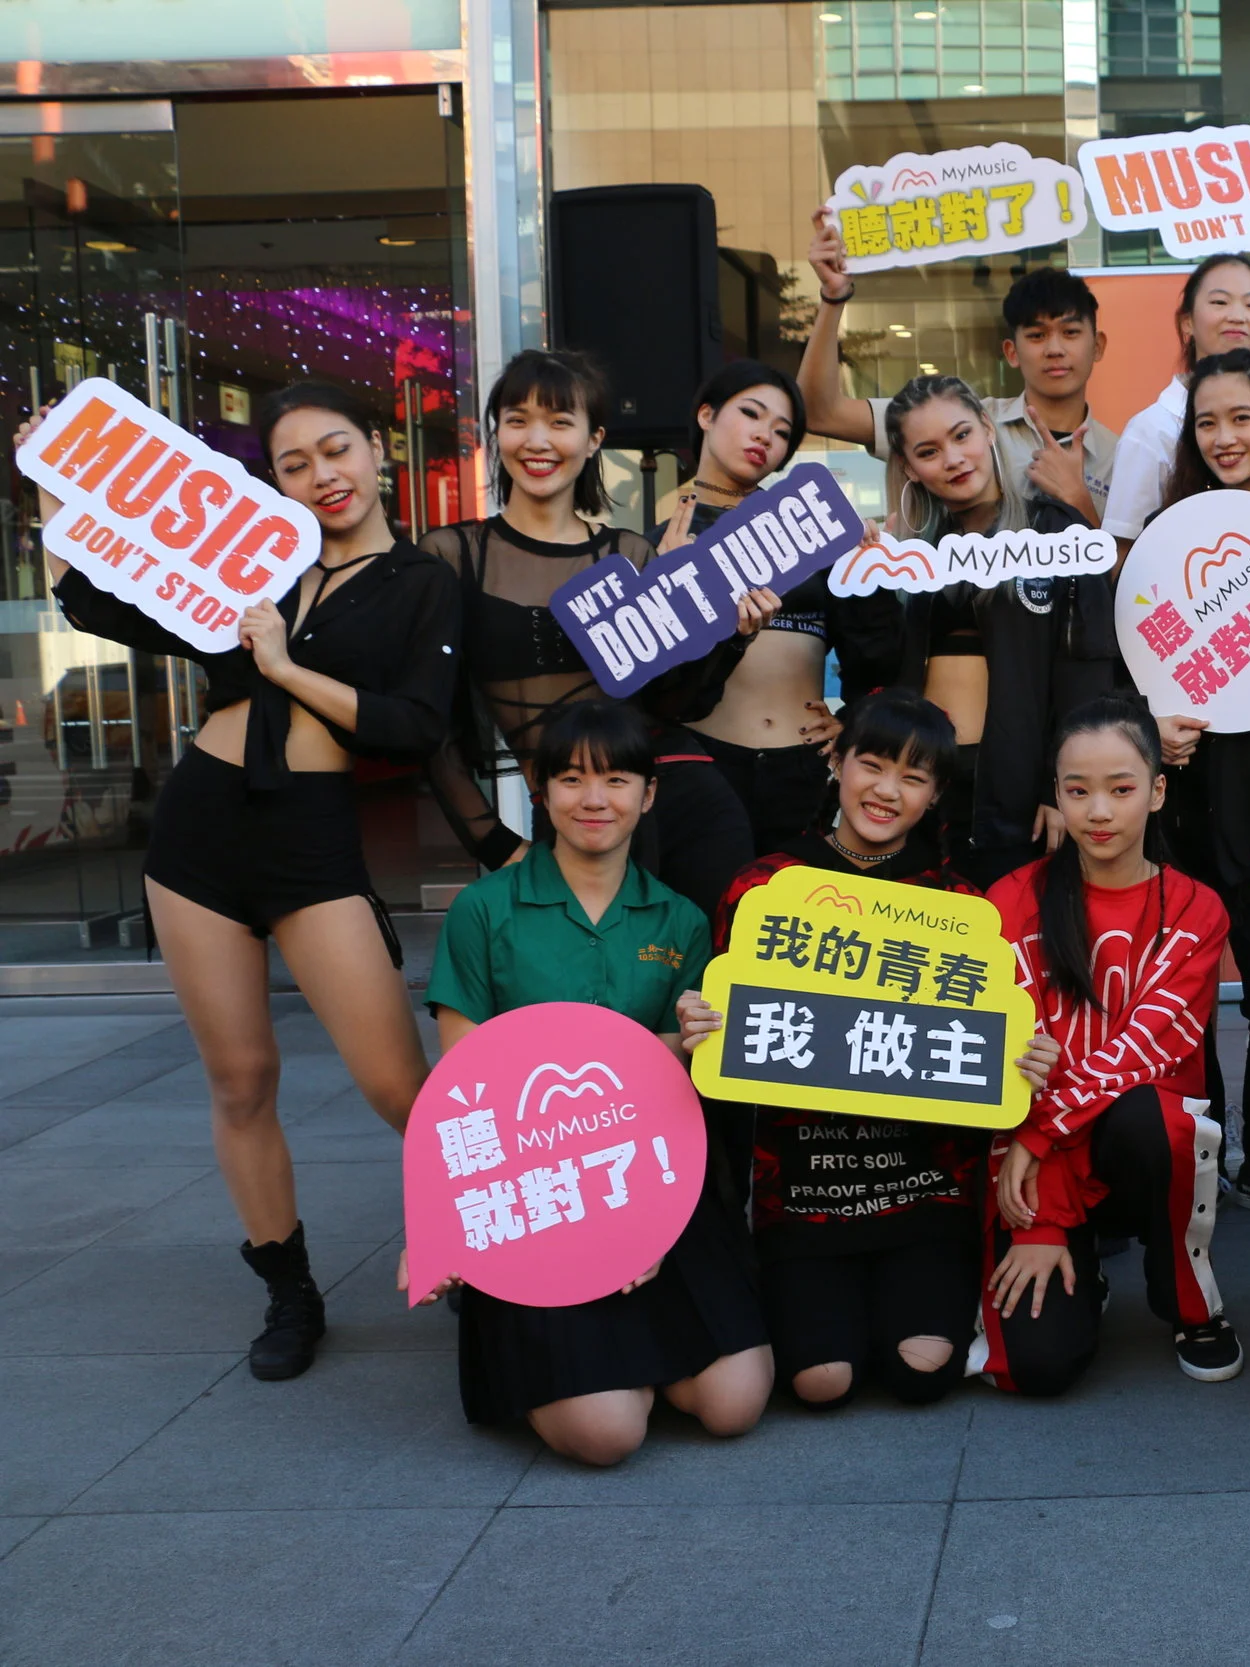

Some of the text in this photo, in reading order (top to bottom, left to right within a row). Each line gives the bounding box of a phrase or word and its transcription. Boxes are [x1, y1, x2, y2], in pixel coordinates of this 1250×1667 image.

[941, 159, 1017, 183] MyMusic
[1174, 212, 1246, 244] DON'T
[39, 396, 300, 596] MUSIC
[65, 513, 238, 632] DON'T STOP
[584, 480, 846, 681] DON'T JUDGE
[949, 536, 1104, 576] MyMusic
[567, 572, 625, 624] WTF
[1030, 590, 1048, 600] BOY
[1136, 600, 1194, 662] 聽
[871, 901, 970, 936] MyMusic
[756, 914, 989, 1007] 我的青春
[436, 1108, 507, 1179] 聽
[517, 1102, 637, 1153] MyMusic
[798, 1125, 849, 1140] DARK
[810, 1151, 907, 1170] FRTC SOUL
